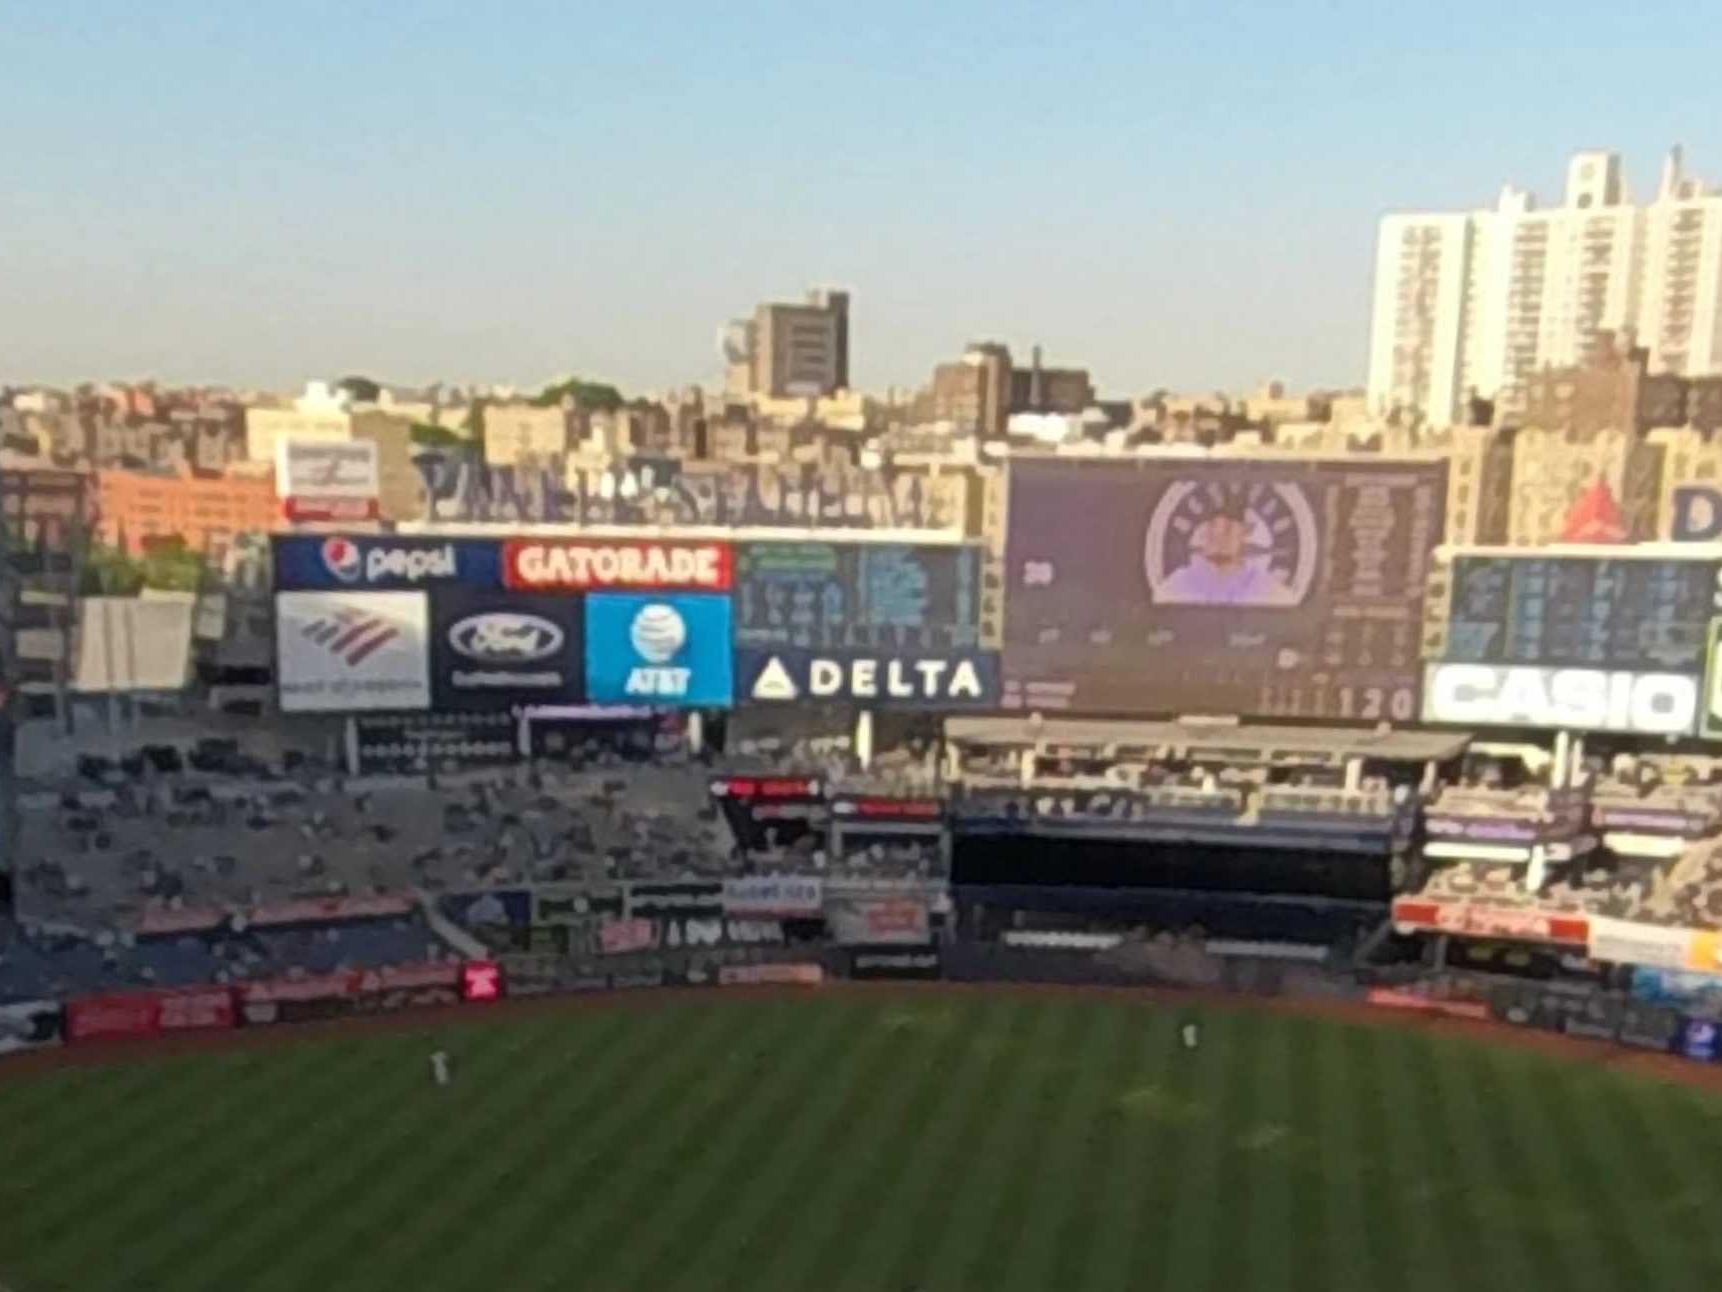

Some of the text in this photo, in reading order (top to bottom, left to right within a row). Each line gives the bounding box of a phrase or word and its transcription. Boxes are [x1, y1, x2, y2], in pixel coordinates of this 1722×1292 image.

[366, 545, 457, 581] pepsi
[517, 546, 721, 584] GATORADE
[809, 658, 983, 699] DELTA
[1433, 664, 1696, 729] CASIO
